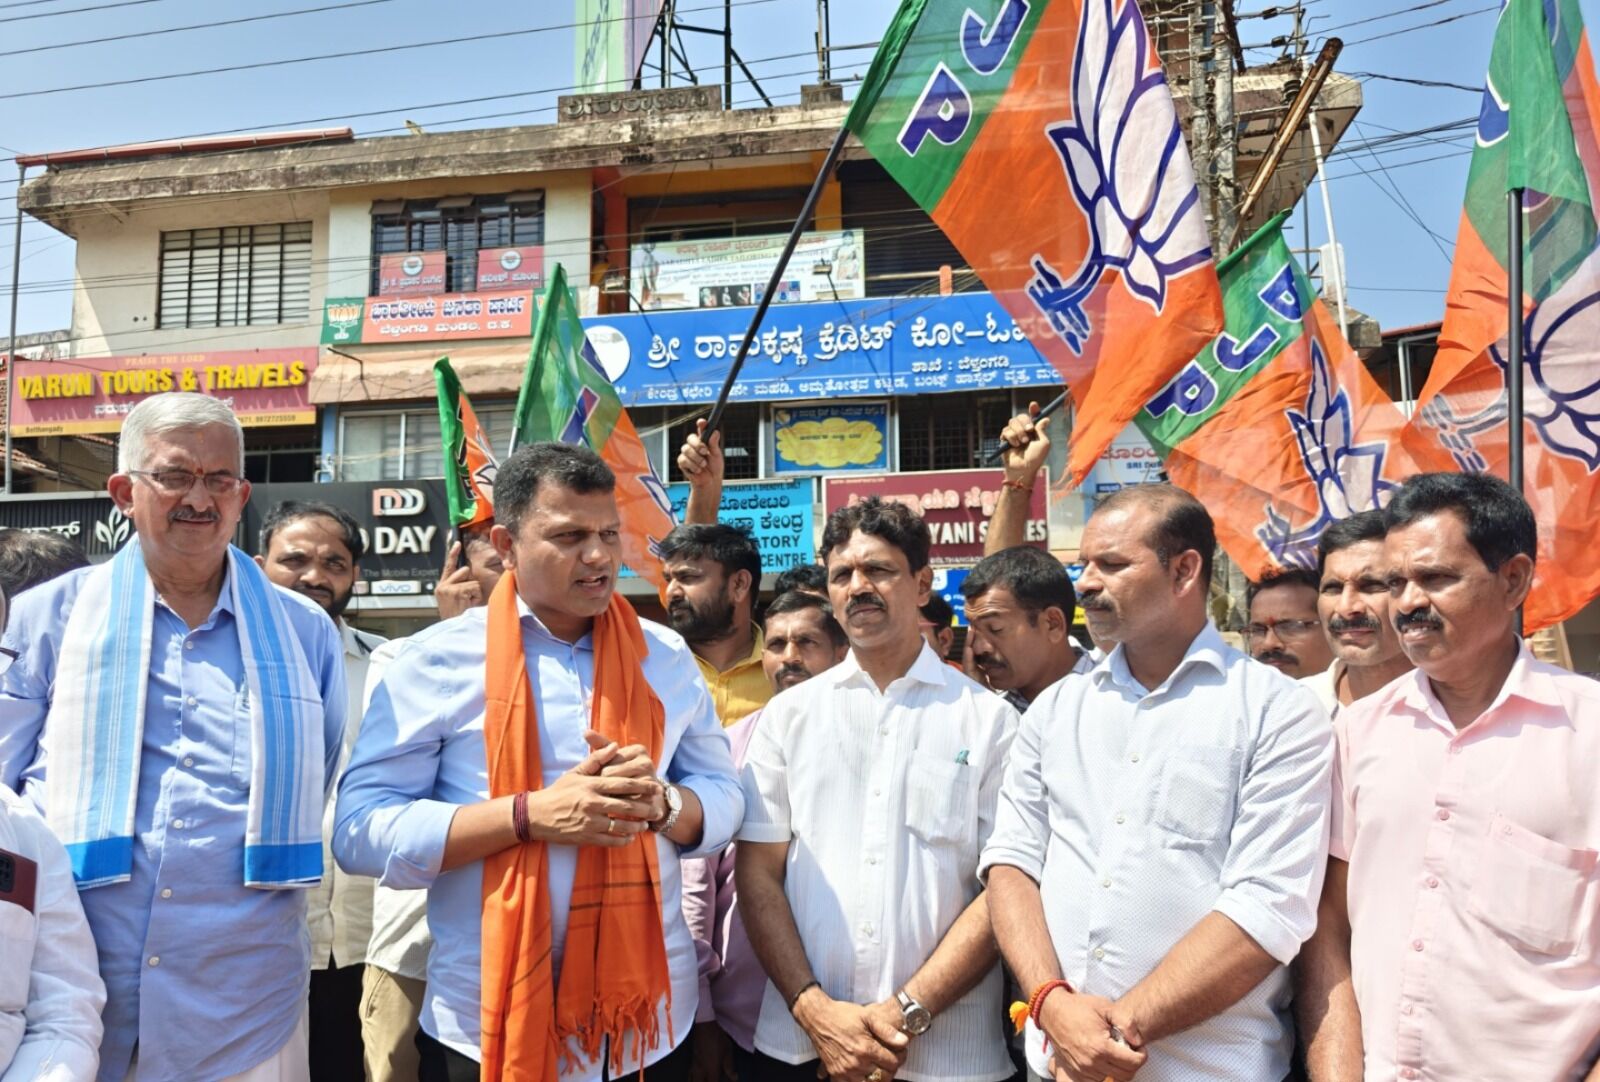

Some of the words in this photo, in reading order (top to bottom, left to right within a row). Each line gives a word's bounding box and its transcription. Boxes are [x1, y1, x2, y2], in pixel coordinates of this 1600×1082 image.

[896, 0, 1031, 157] JP
[371, 298, 436, 323] ಭಾರತೀಯ
[442, 296, 482, 319] ಜನತಾ
[648, 333, 681, 369] ಶ್ರೀ
[694, 325, 808, 365] ರಾಮಕೃಷ್ಣ
[813, 319, 895, 360] ಕ್ರೆಡಿಟ್
[161, 355, 177, 364] THE
[182, 354, 205, 363] LORD
[912, 357, 942, 373] ಶಾಖೆ
[958, 355, 1010, 372] ಬೆಳ್ತಂಗಡಿ
[18, 372, 92, 399] VARUN
[102, 368, 173, 395] TOURS
[180, 367, 197, 392] &
[204, 361, 305, 390] TRAVELS
[760, 510, 804, 533] ಕೇಂದ್ರ
[373, 525, 437, 555] DAY
[756, 536, 800, 549] TORY
[929, 522, 974, 545] YANI
[363, 569, 379, 577] The
[381, 568, 409, 577] Mobile
[379, 584, 411, 592] vivo
